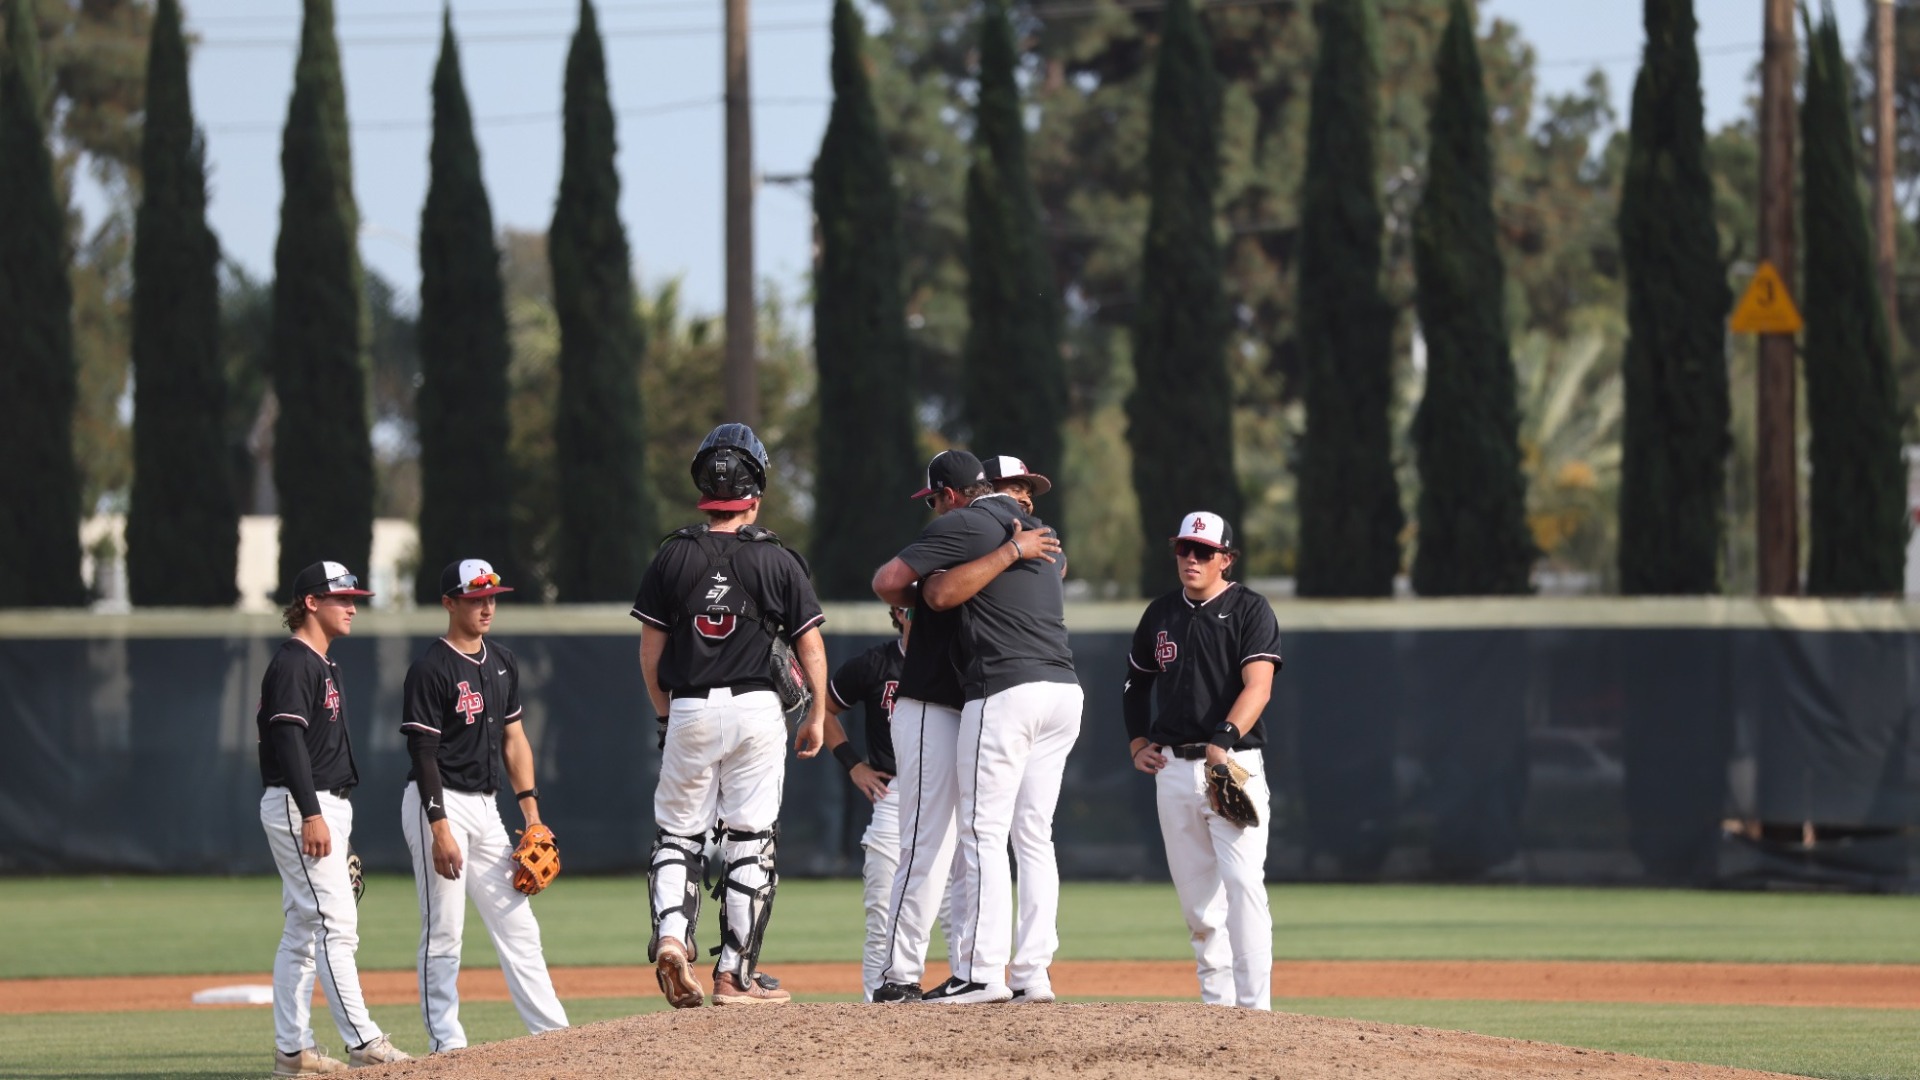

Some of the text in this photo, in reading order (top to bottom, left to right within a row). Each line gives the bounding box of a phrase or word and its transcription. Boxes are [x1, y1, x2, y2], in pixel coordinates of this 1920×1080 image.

[1192, 517, 1206, 533] AP
[1155, 631, 1178, 672] AP
[456, 681, 484, 724] AP
